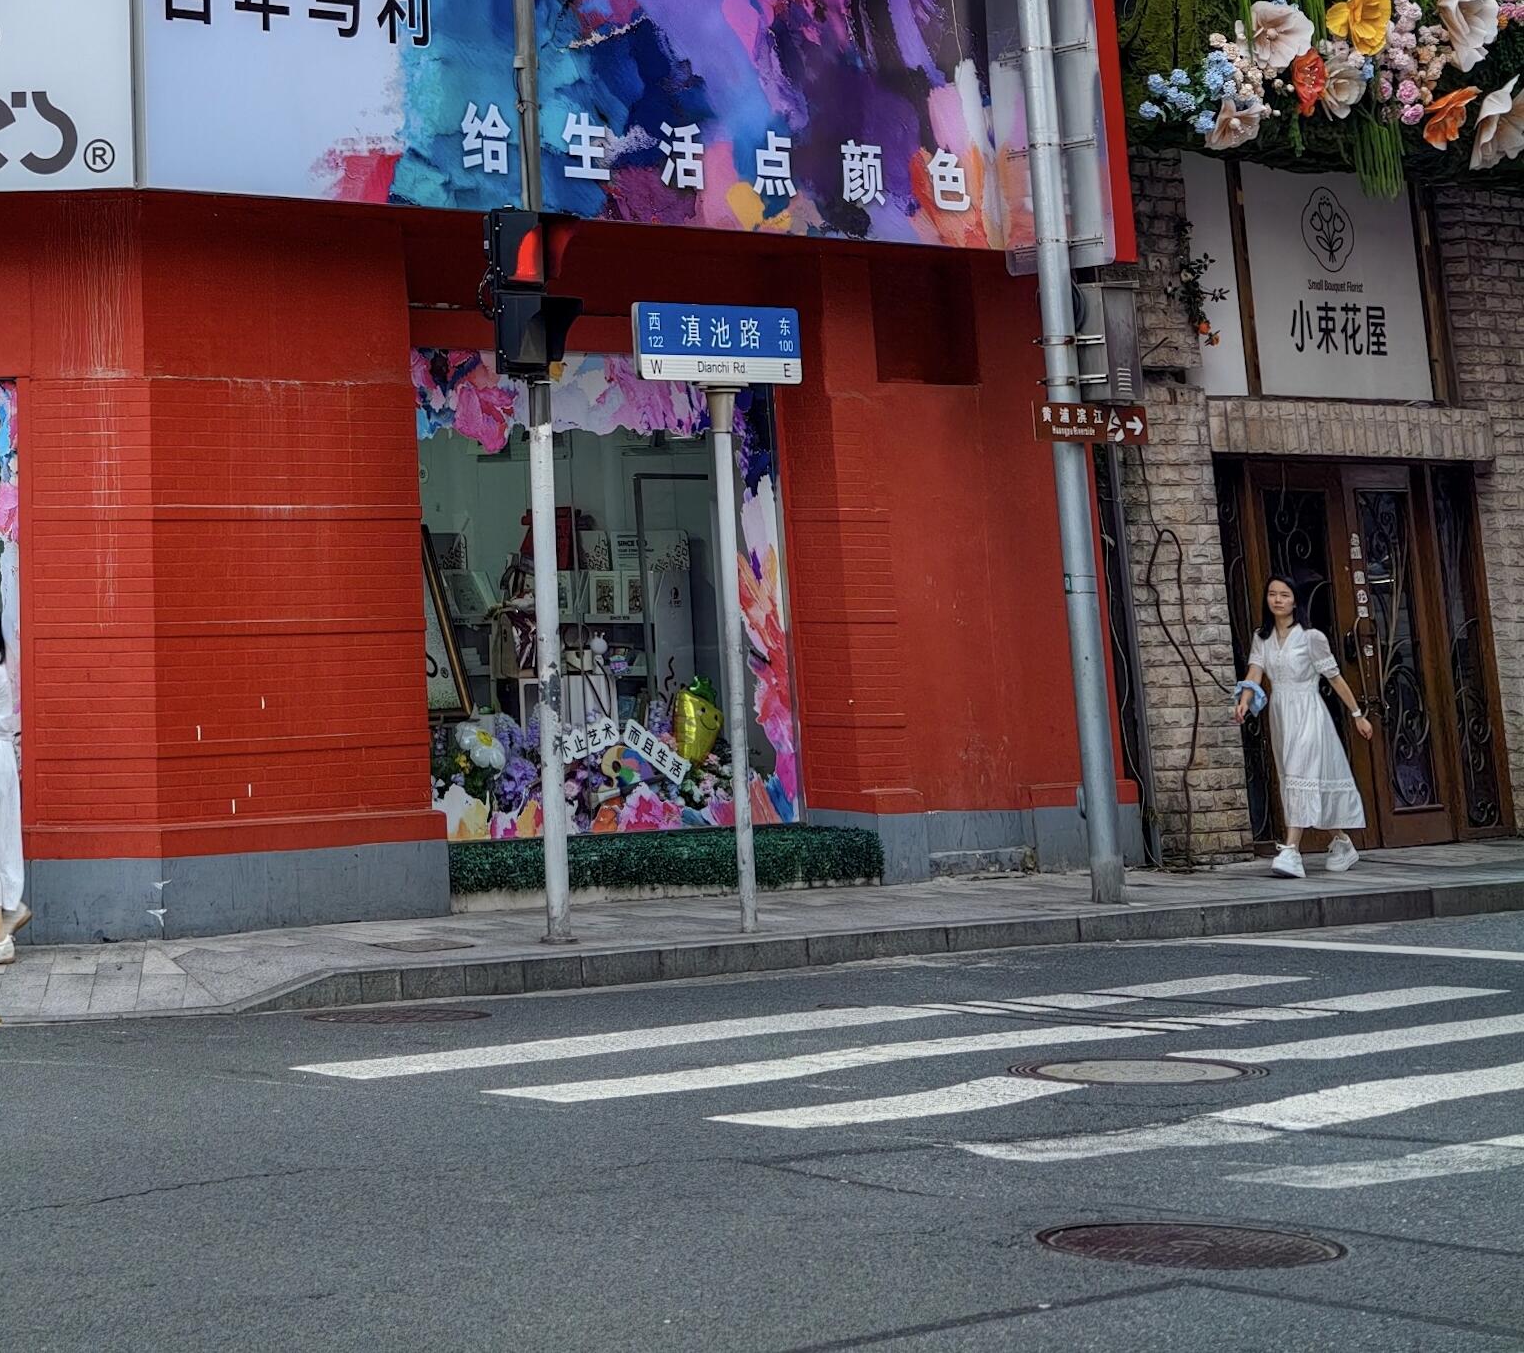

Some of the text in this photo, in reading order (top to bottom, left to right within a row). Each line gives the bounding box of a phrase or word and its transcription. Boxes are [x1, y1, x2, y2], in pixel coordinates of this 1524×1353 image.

[460, 101, 973, 214] 给生活点颜色
[647, 312, 791, 350] 西 滇池路 东
[648, 336, 794, 353] 122 100
[1291, 300, 1388, 356] 小束花屋
[650, 359, 663, 374] W
[697, 361, 730, 374] Dianchi
[783, 363, 792, 378] E
[1042, 406, 1104, 424] 黄浦滨江
[628, 725, 683, 778] 而且生活
